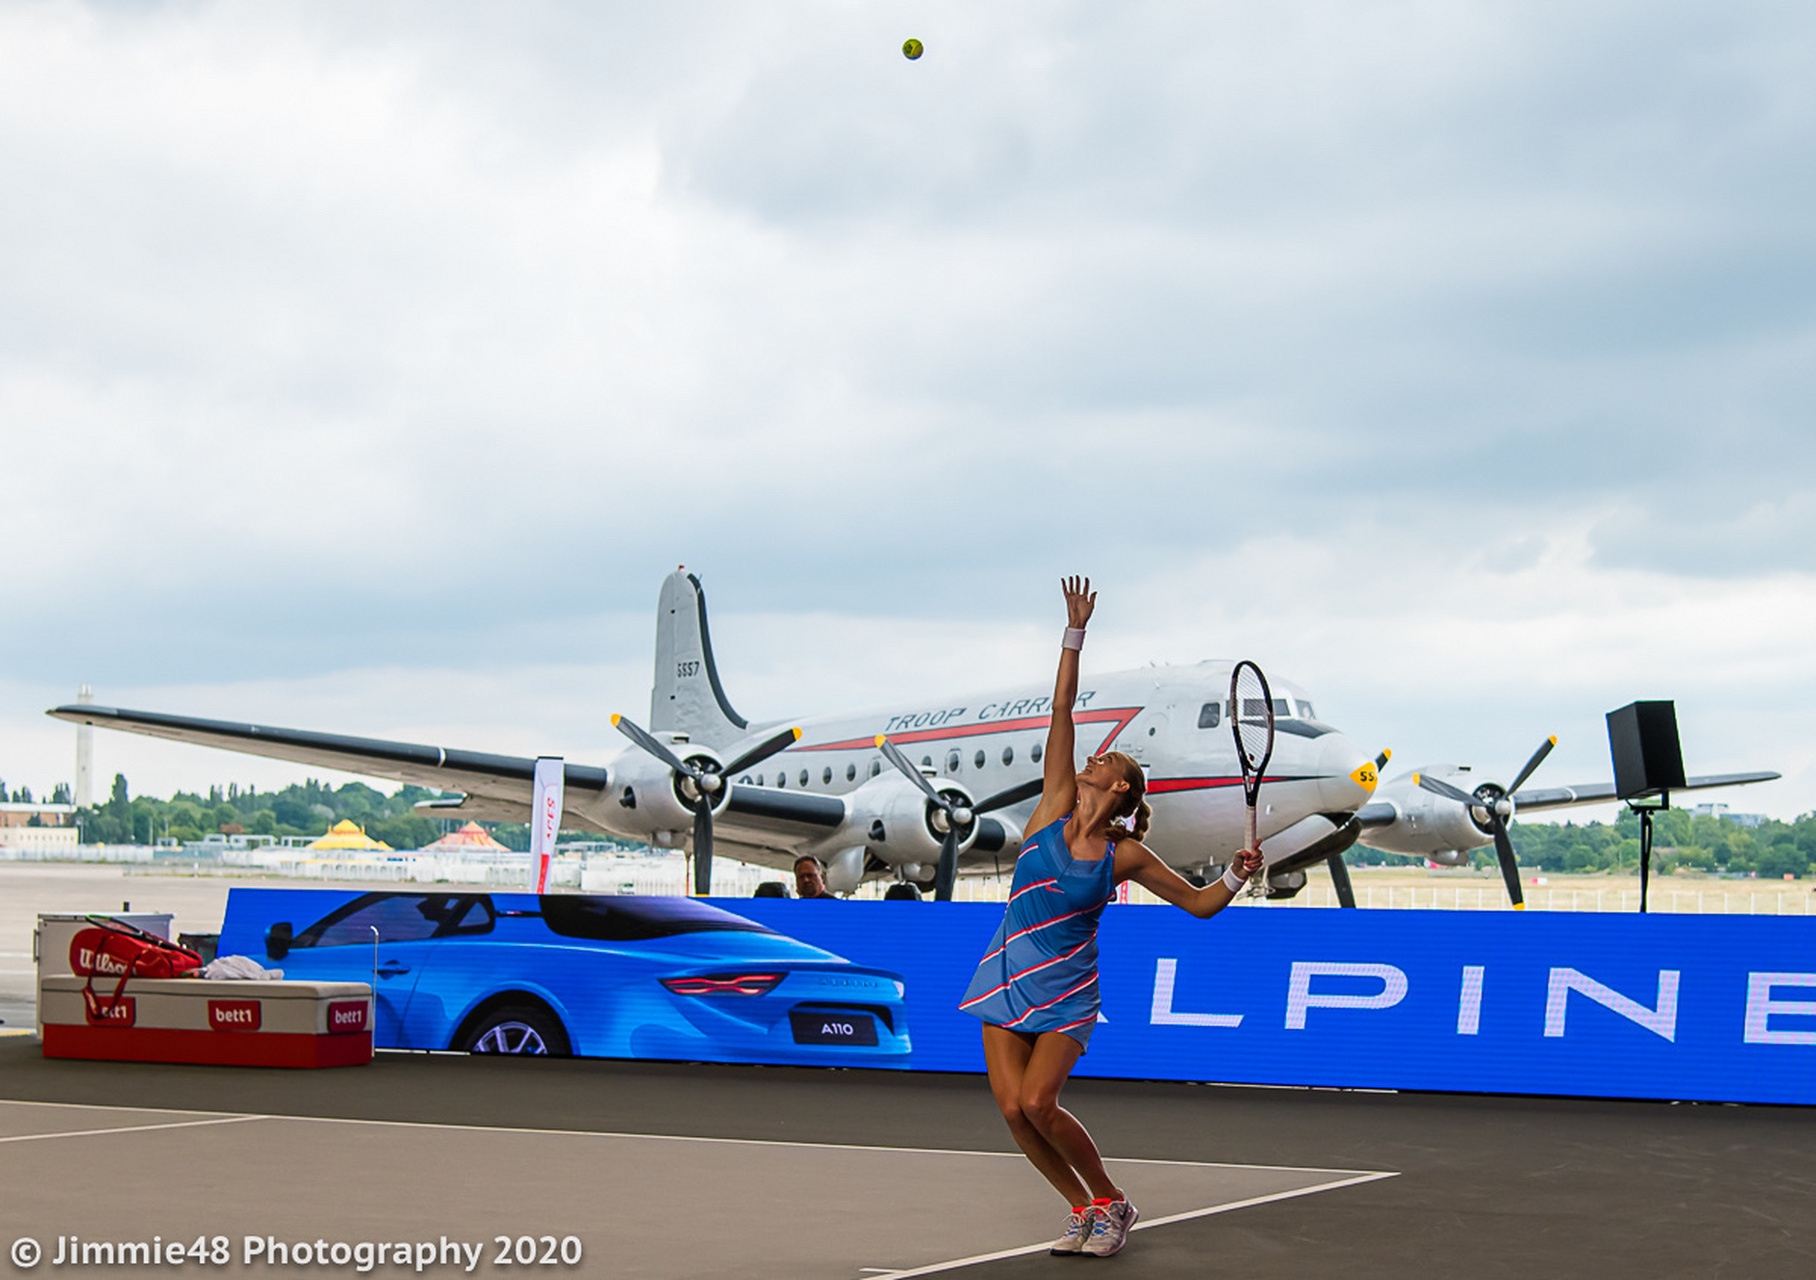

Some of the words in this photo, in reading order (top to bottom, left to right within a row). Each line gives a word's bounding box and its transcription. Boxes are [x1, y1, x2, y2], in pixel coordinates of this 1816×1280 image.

[885, 707, 967, 732] TROOP
[1097, 957, 1816, 1046] LPINE
[101, 1005, 127, 1019] ett1
[215, 1007, 253, 1023] bett1
[334, 1010, 362, 1024] bett1
[821, 1022, 854, 1036] A110
